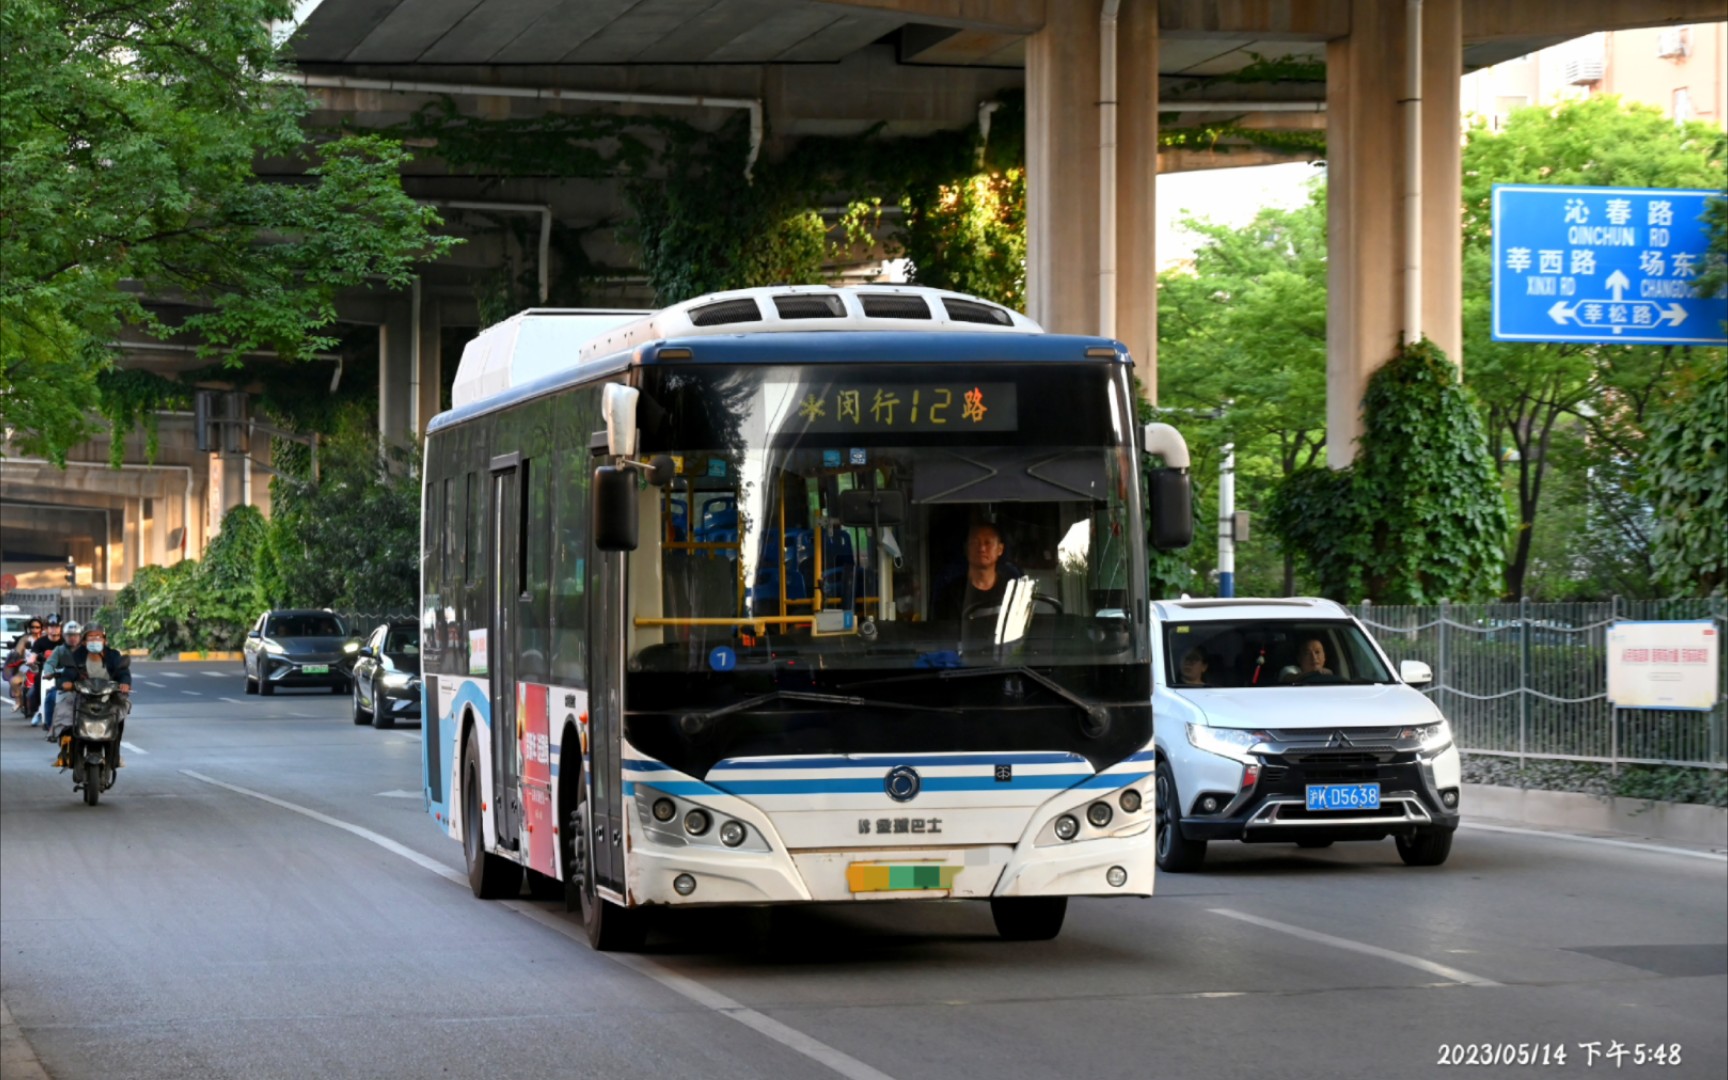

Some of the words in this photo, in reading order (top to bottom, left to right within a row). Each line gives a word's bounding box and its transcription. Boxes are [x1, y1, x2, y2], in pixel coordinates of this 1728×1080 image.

[1564, 198, 1674, 227] 沁春路
[1568, 226, 1636, 247] QINCHUN
[1649, 228, 1670, 248] RD
[1506, 247, 1597, 275] 莘西路
[1526, 276, 1556, 296] XINXI
[1560, 276, 1577, 296] RD
[1583, 303, 1652, 325] 莘松路
